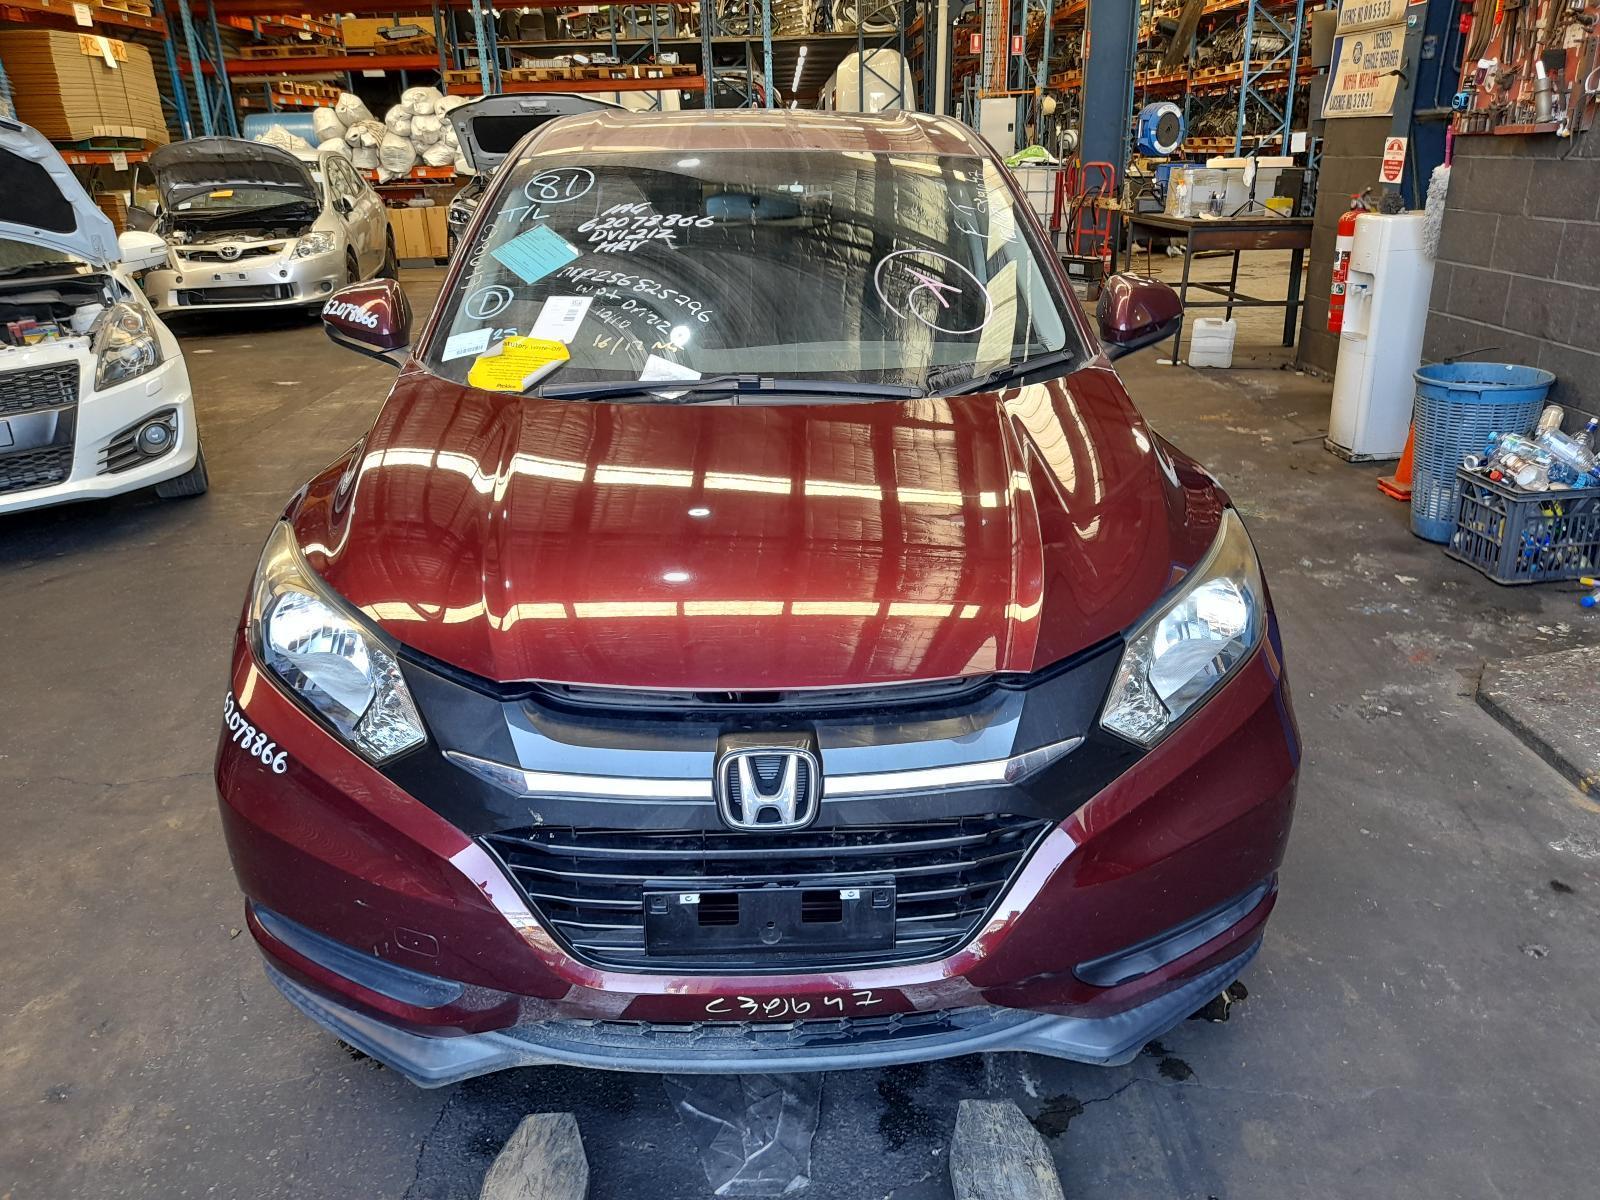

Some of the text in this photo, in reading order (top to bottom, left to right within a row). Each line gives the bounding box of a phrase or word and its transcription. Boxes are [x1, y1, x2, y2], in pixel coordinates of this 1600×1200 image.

[533, 175, 578, 198] 81
[578, 214, 715, 232] 62078866
[323, 299, 379, 328] 62078866
[224, 691, 288, 774] 62078866
